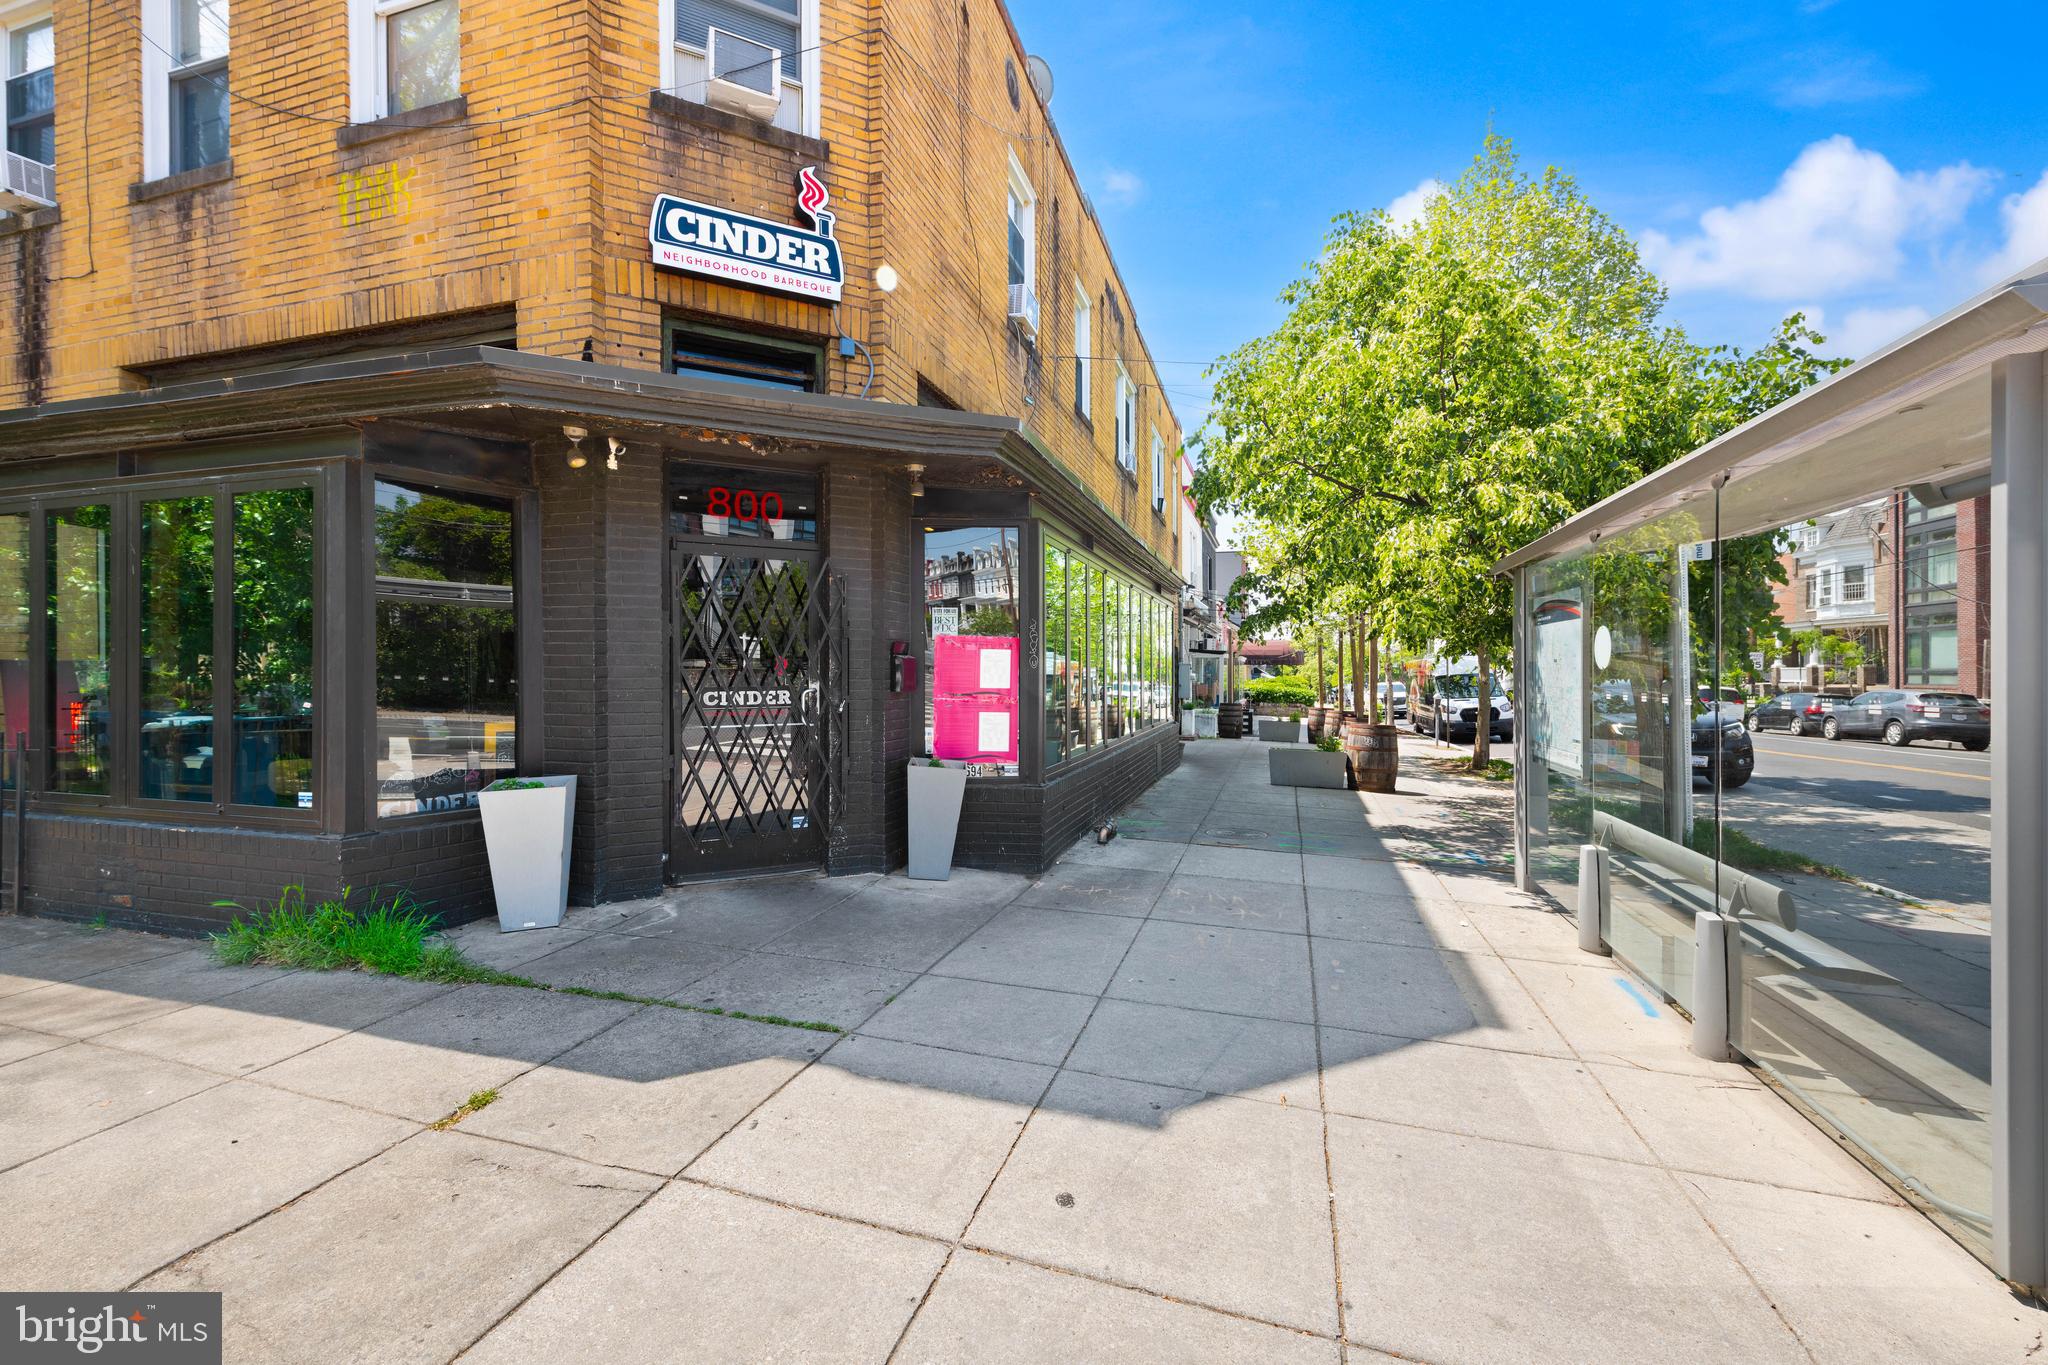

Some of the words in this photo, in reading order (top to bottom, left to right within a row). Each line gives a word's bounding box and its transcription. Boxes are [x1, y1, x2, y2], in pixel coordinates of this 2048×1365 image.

[665, 207, 832, 275] CINDER
[663, 250, 767, 280] NEIGHBORHOOD
[773, 274, 832, 294] BARBEQUE
[707, 487, 783, 524] 800
[934, 616, 956, 624] BEST
[702, 689, 792, 706] CINDER
